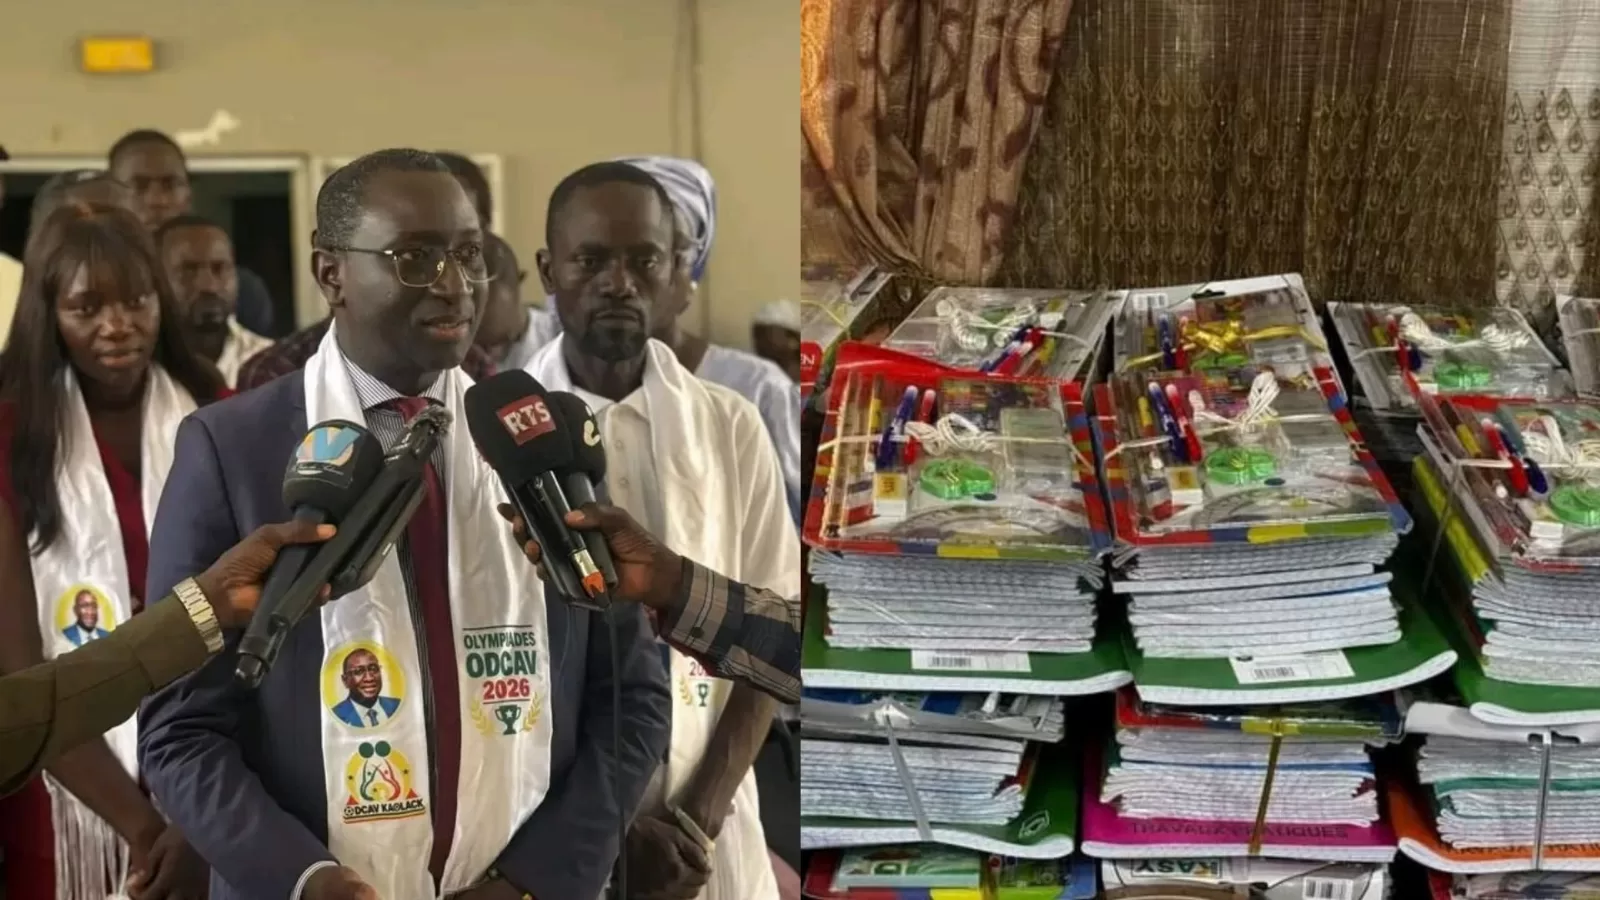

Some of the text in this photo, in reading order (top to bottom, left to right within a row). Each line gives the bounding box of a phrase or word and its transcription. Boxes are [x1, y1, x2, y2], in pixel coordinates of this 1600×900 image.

[503, 401, 551, 435] RTS
[463, 631, 536, 649] OLYMPIADES
[466, 650, 537, 678] ODCAV
[483, 678, 530, 700] 2026
[381, 799, 424, 812] KAOLACK
[1132, 822, 1225, 836] TRAVAUX
